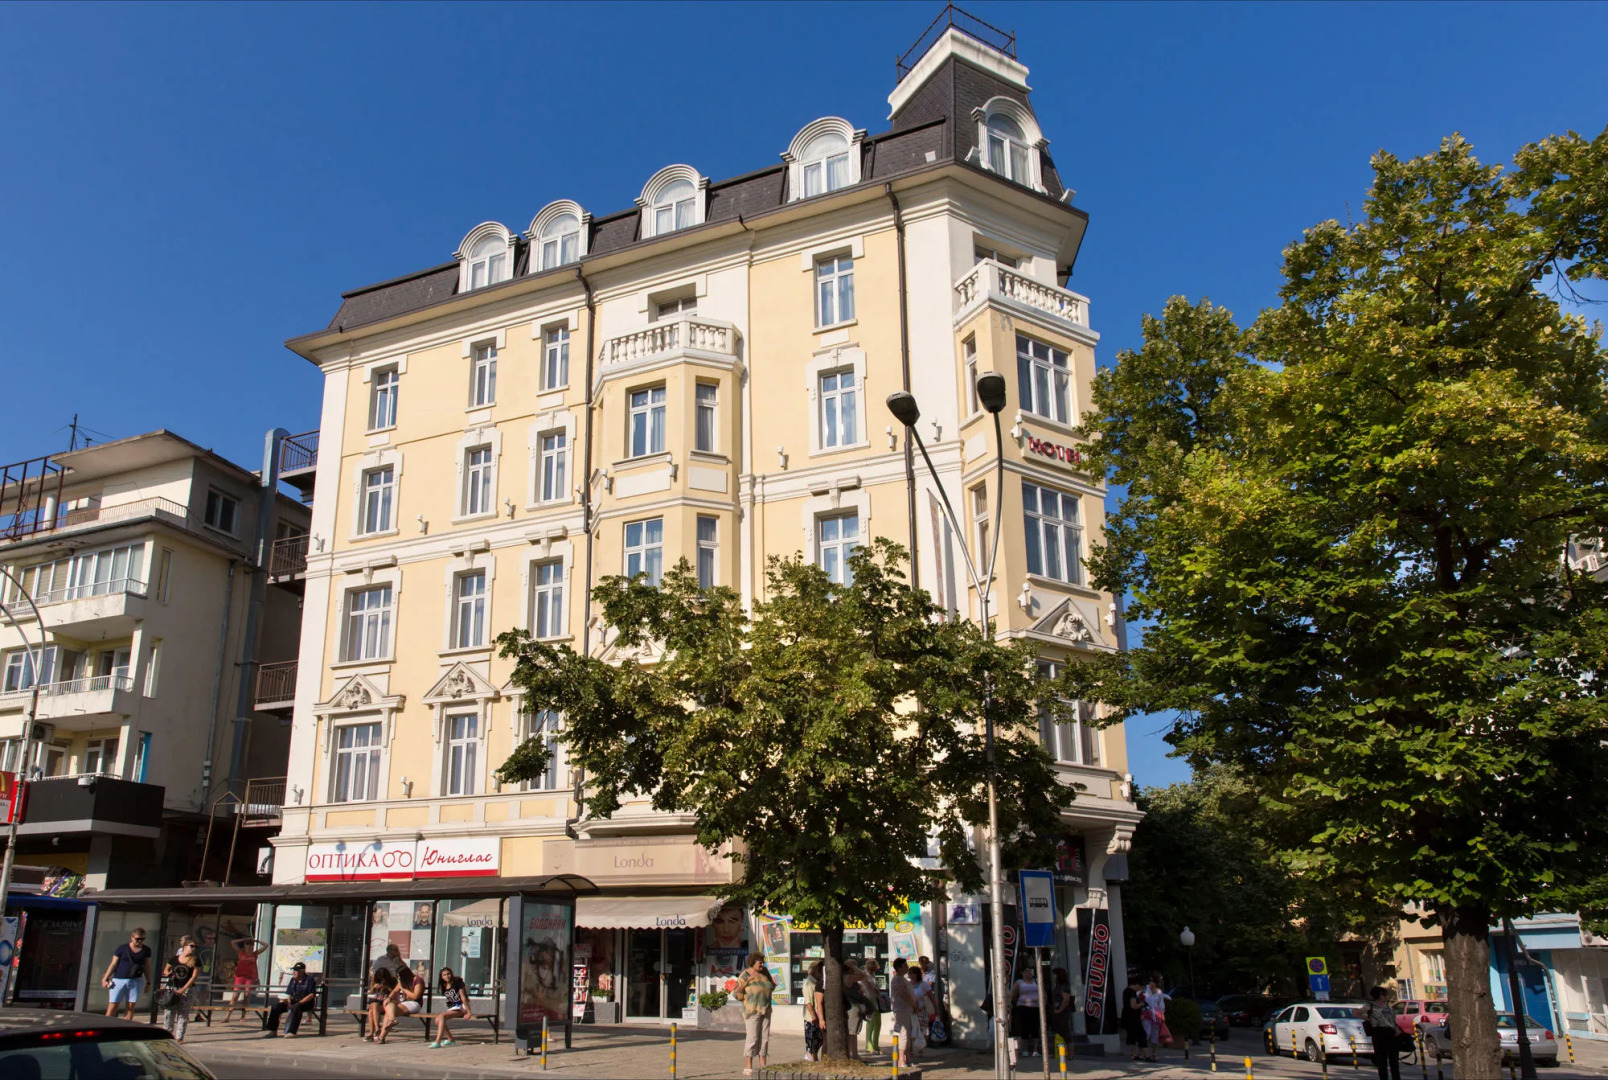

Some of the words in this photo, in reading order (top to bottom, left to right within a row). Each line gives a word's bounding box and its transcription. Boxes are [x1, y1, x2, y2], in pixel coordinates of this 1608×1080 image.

[1029, 436, 1080, 464] HOTEL
[308, 852, 379, 869] ОПТИКА
[421, 846, 493, 869] Юниглас
[613, 852, 654, 869] Londa
[466, 914, 493, 926] Londa
[656, 914, 686, 926] Londa
[1086, 923, 1109, 1018] STUDIO
